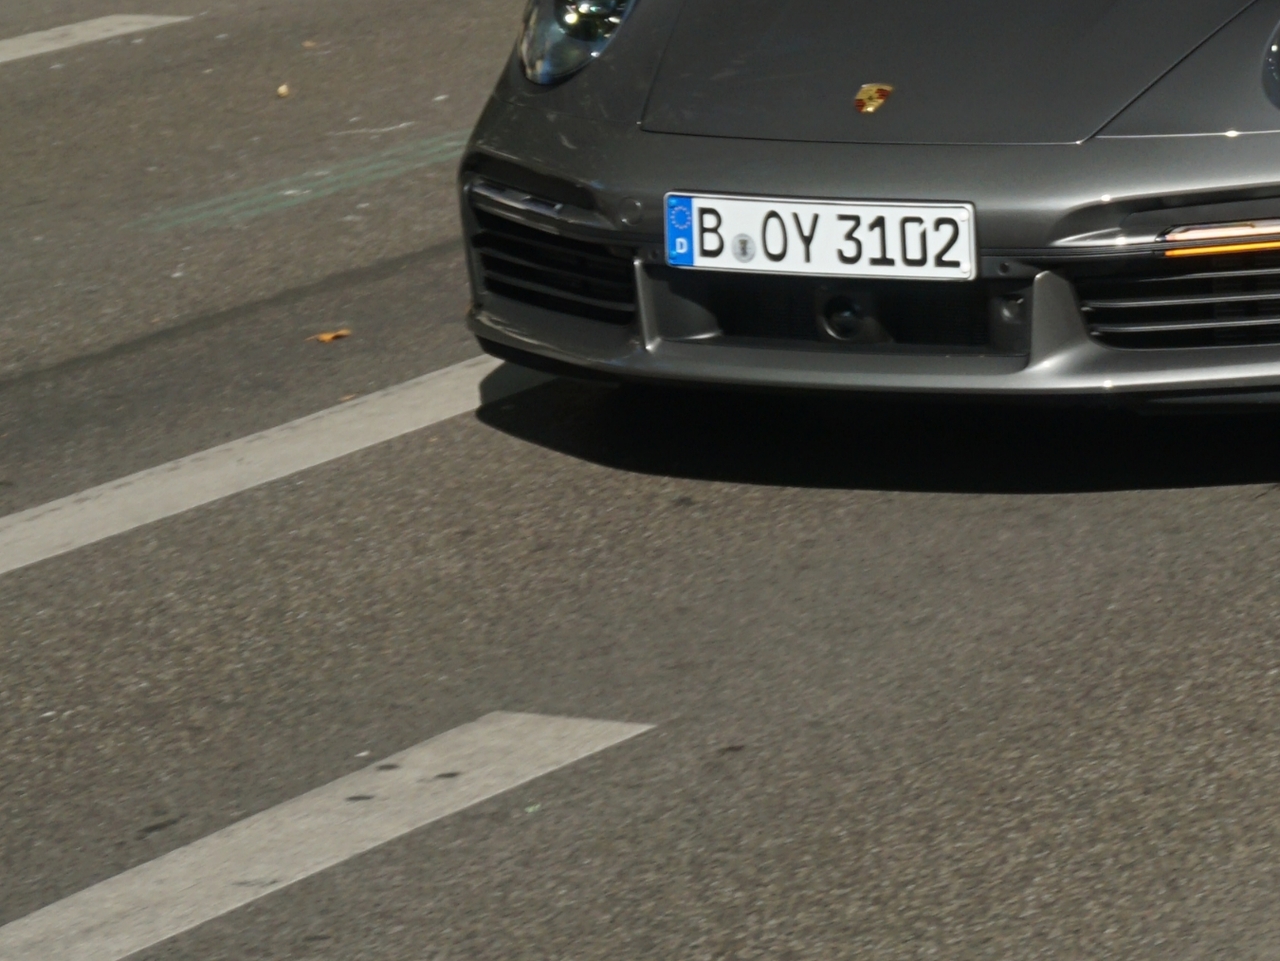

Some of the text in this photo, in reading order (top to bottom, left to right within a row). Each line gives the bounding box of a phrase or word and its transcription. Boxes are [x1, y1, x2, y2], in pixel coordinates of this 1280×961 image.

[676, 237, 688, 253] D
[697, 207, 961, 268] B OY 3102
